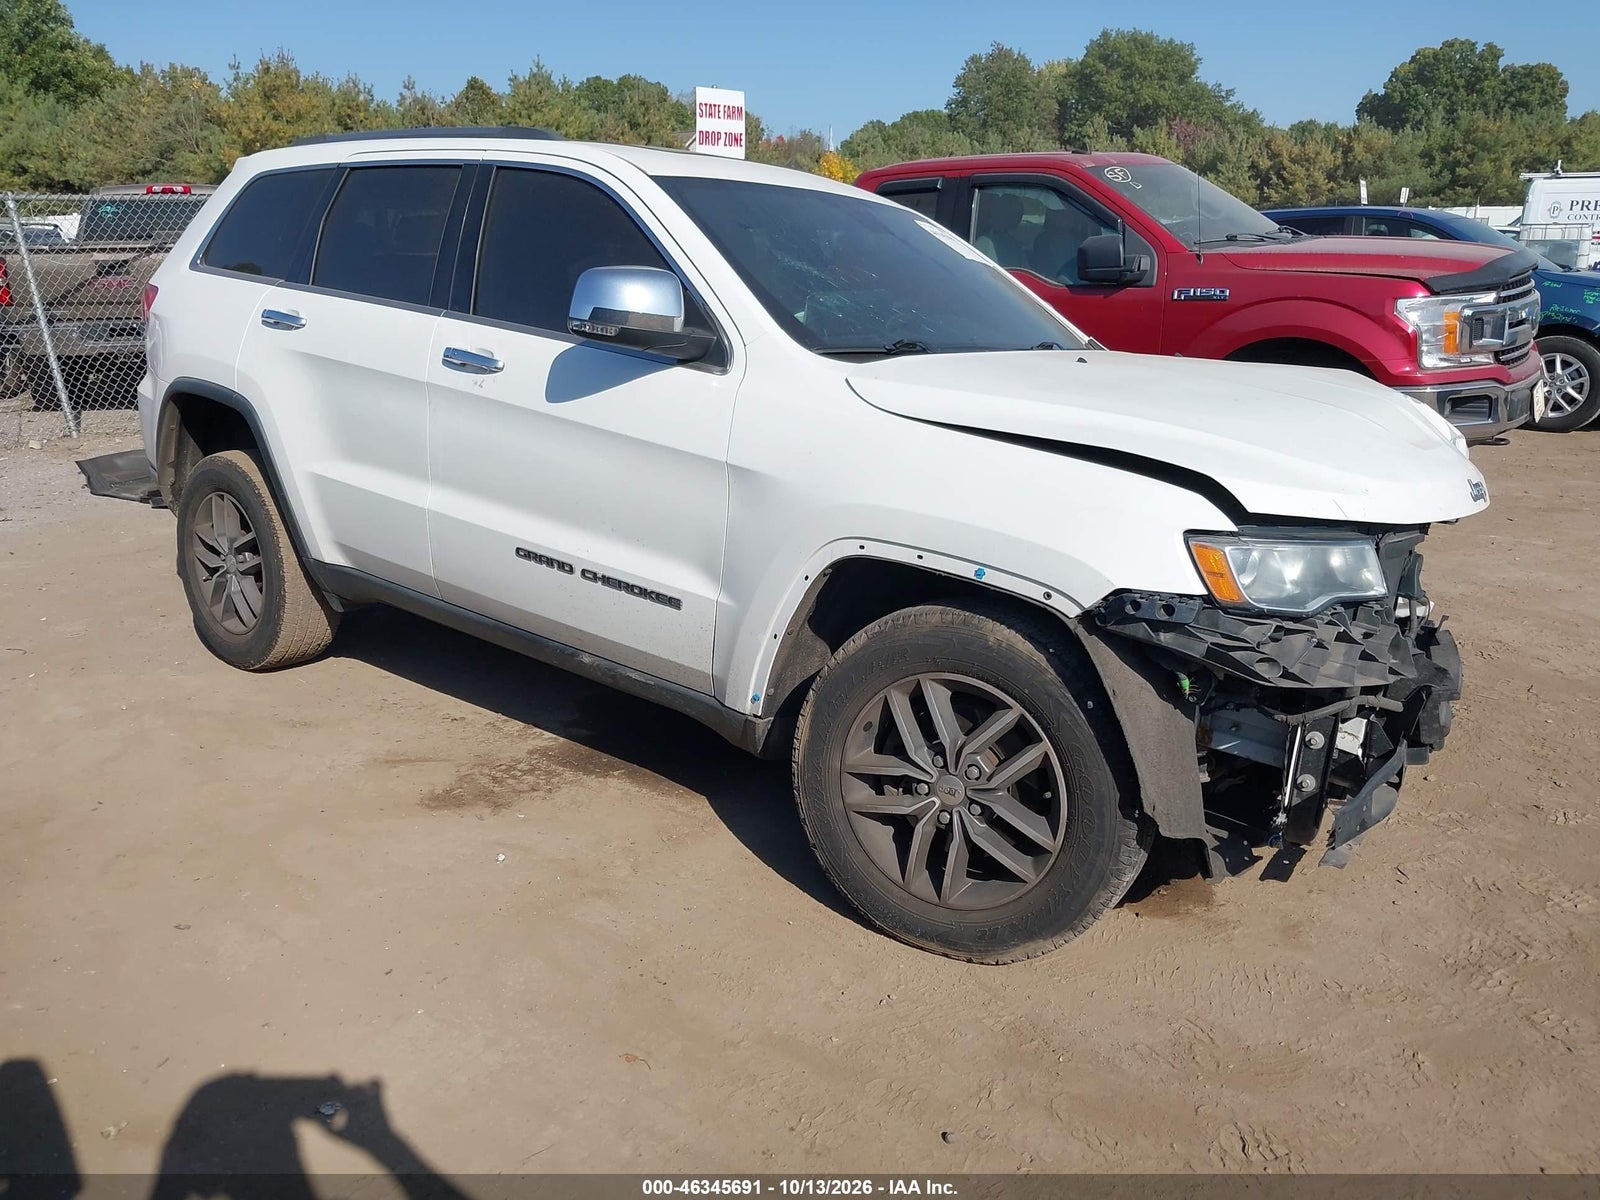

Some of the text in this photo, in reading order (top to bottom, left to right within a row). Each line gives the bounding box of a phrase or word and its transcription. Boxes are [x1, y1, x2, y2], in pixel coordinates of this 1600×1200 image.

[698, 102, 743, 121] STATE FARM
[698, 130, 743, 148] DROP ZONE
[515, 547, 683, 611] GRAND CHEROKEE
